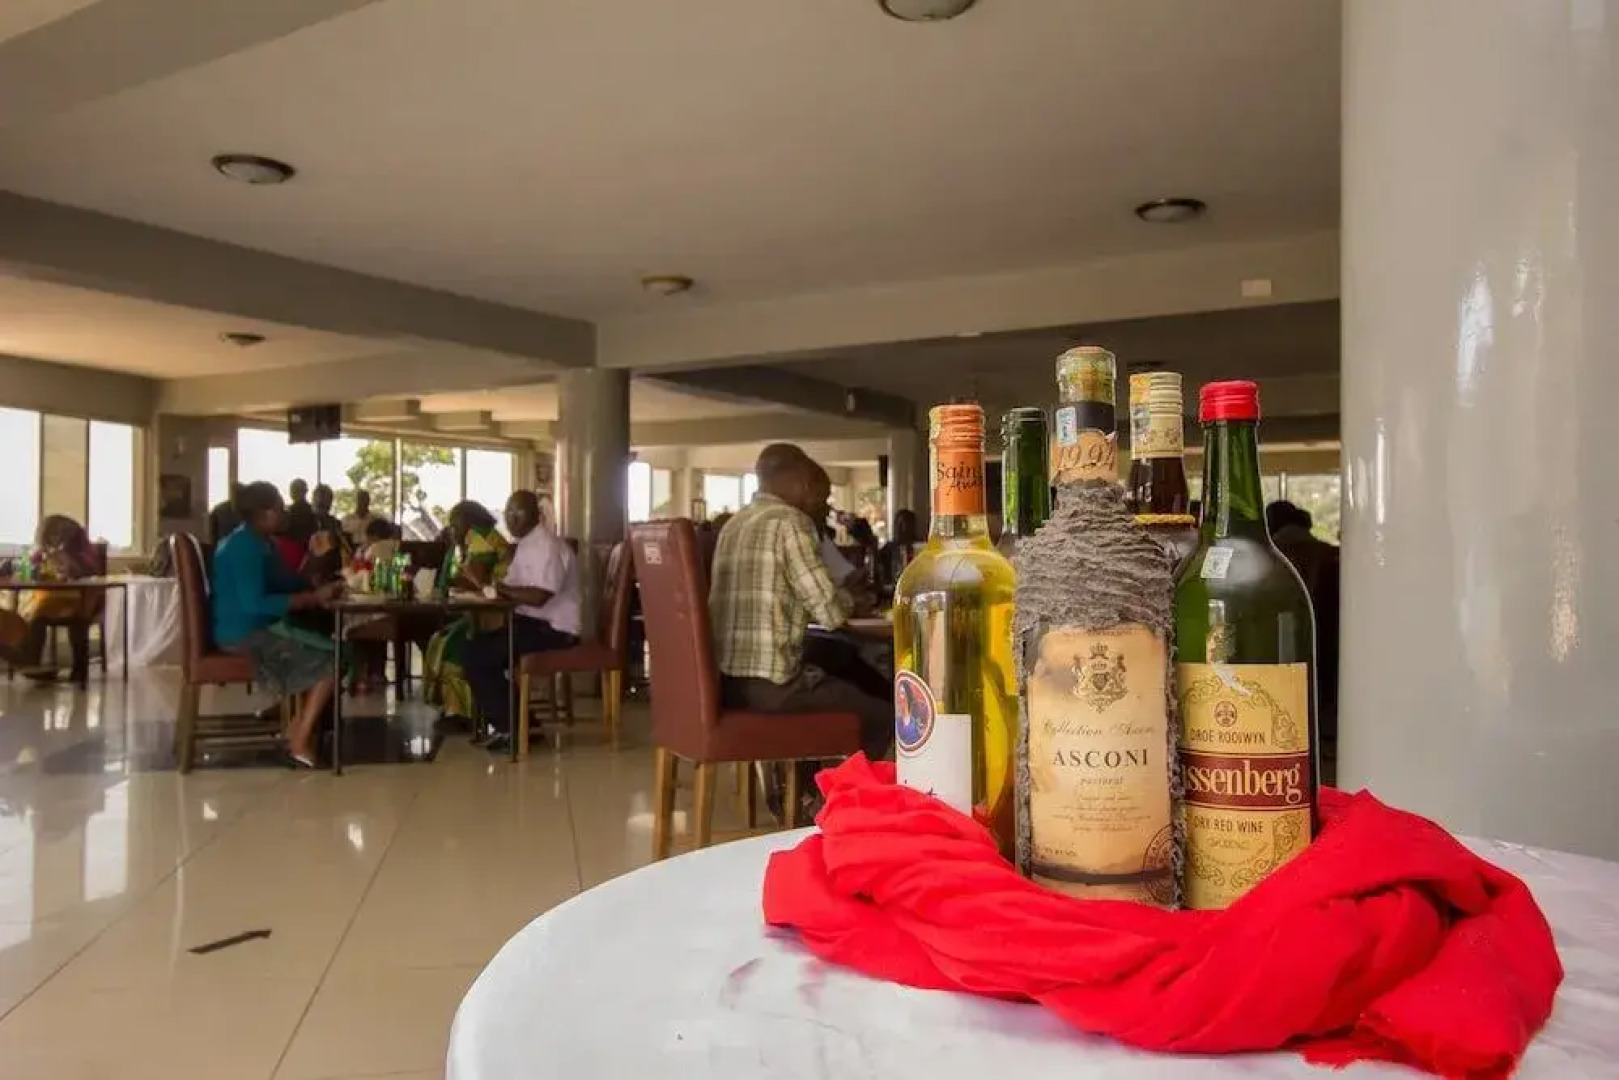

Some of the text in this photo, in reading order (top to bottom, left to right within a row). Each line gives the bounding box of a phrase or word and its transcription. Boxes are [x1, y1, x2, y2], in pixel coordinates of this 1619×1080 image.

[1053, 749, 1148, 768] ASCONI
[1214, 818, 1233, 832] RED
[1236, 820, 1264, 833] WINE
